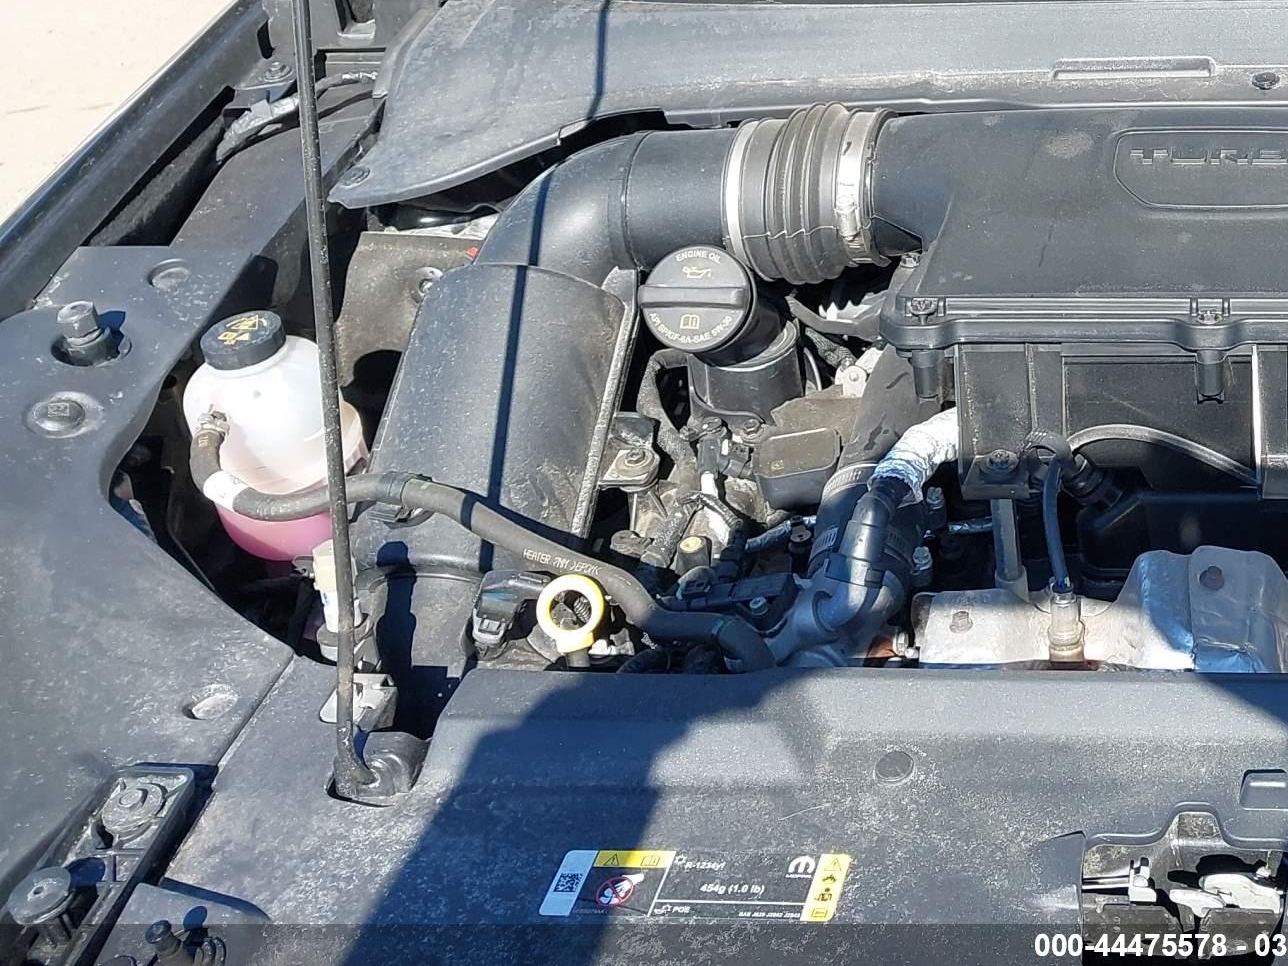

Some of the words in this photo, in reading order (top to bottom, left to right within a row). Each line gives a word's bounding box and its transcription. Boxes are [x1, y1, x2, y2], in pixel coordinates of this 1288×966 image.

[675, 249, 708, 262] ENGINE
[708, 252, 721, 264] OIL
[522, 547, 552, 565] HEATER
[684, 861, 727, 871] R-1234yf
[699, 883, 727, 895] 454g
[728, 883, 749, 894] (1.0
[750, 884, 765, 895] lb)
